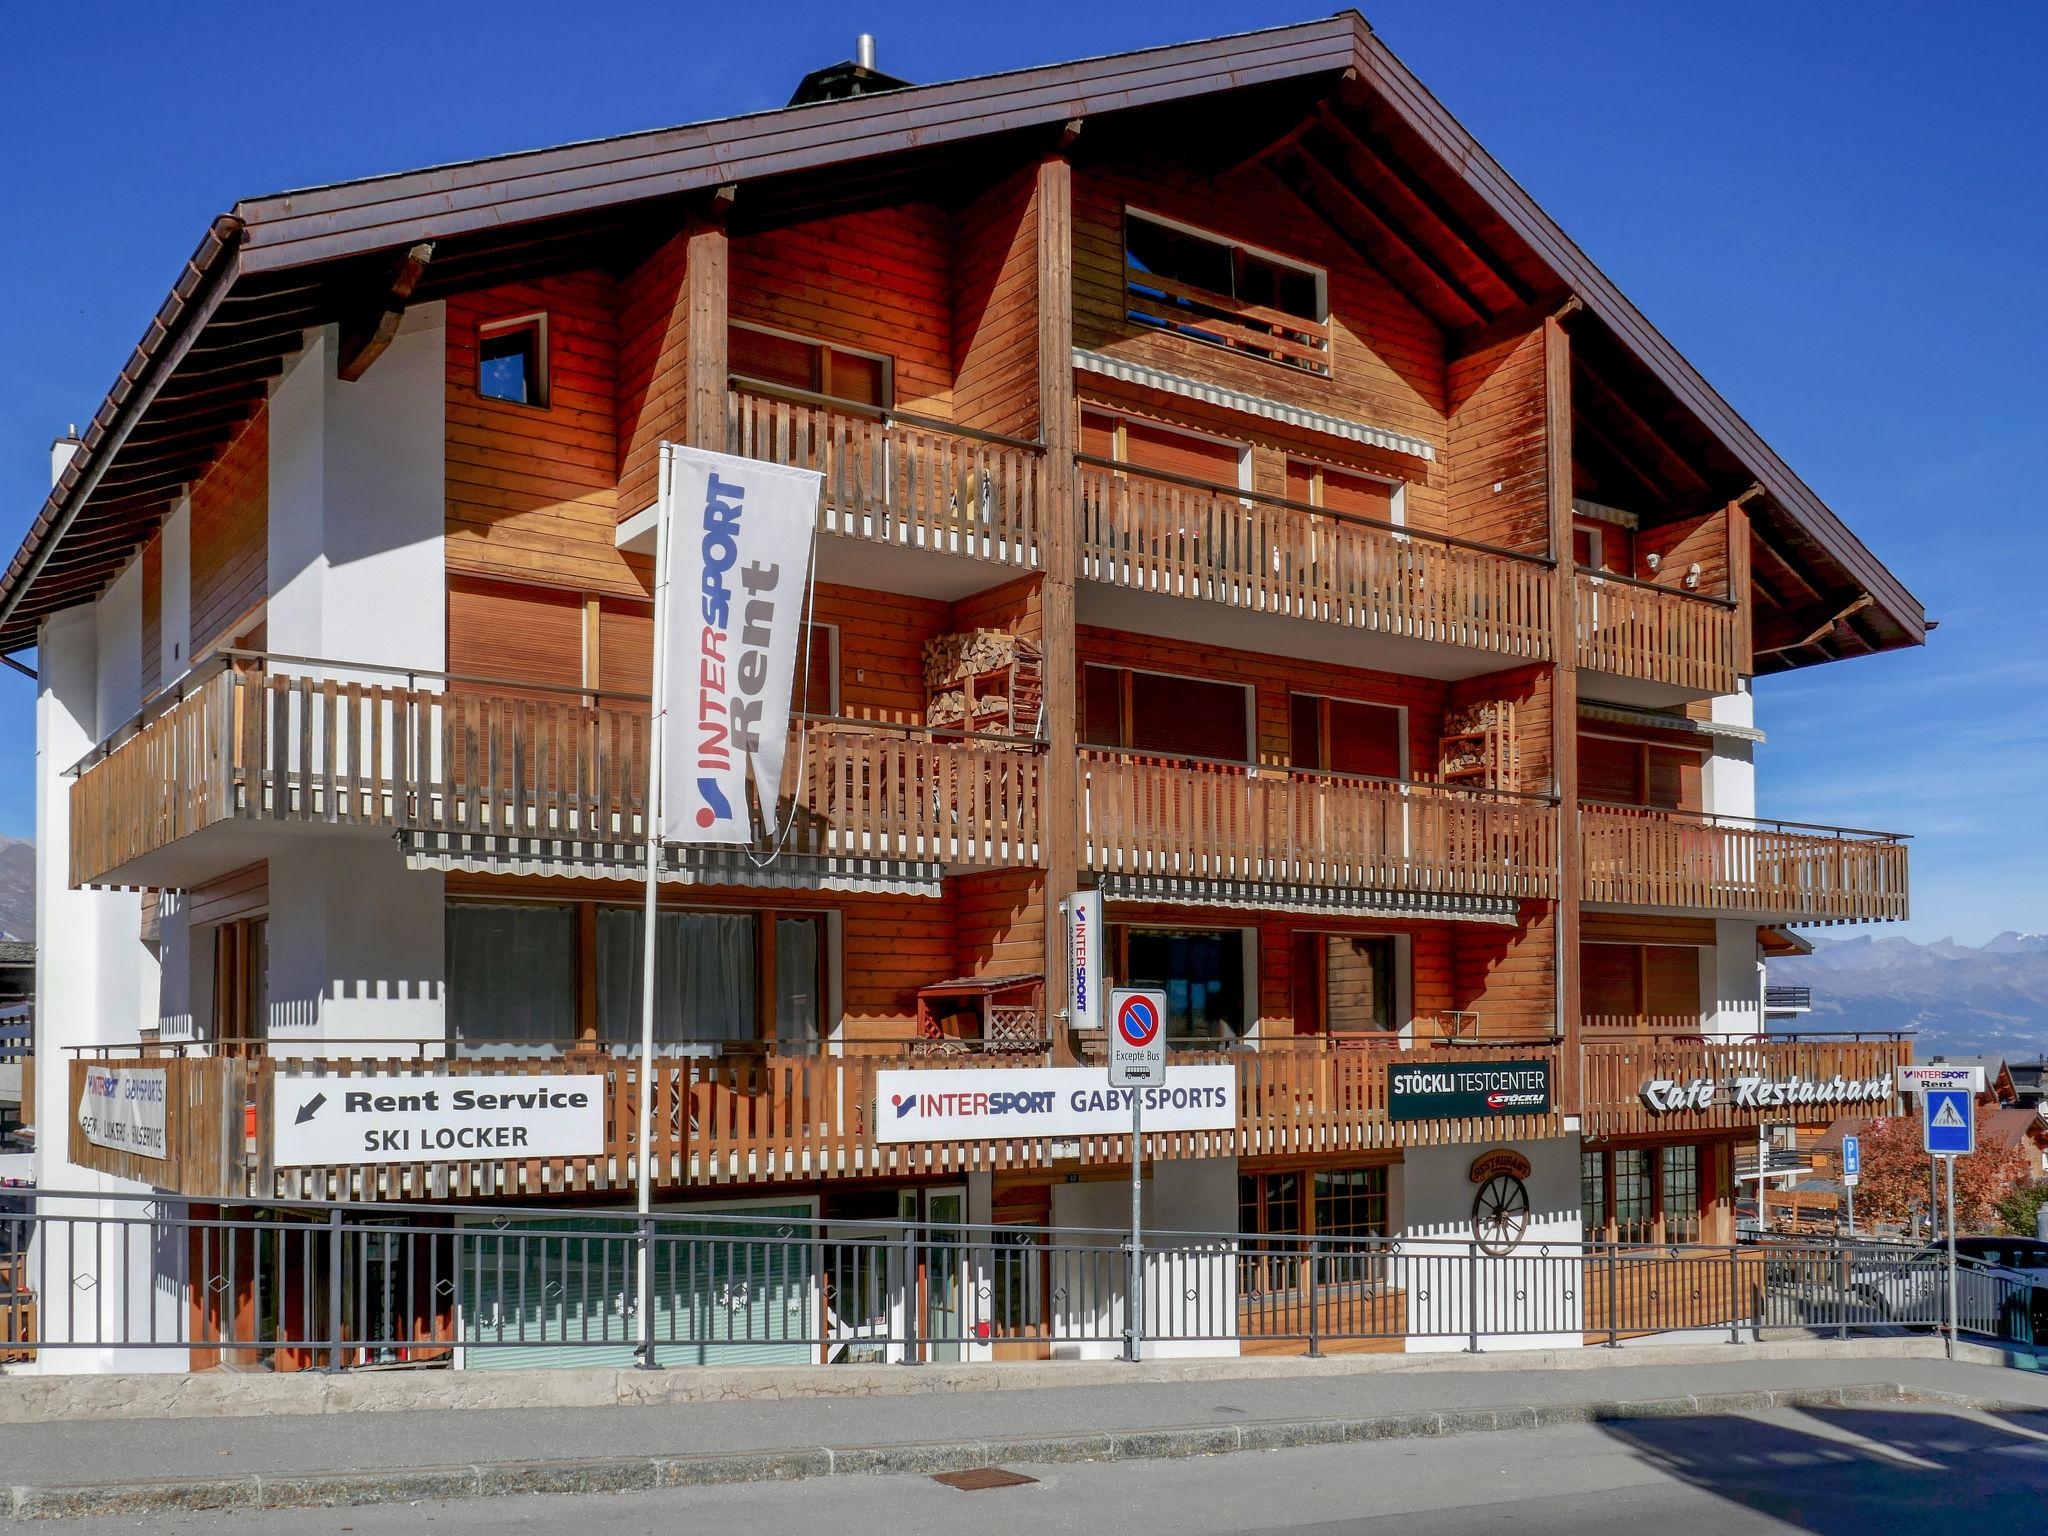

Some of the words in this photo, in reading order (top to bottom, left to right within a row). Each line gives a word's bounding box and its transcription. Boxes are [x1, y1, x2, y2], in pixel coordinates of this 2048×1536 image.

[696, 473, 746, 771] INTERSPORT
[730, 559, 780, 754] Rent
[1075, 923, 1087, 1011] INTERSPORT
[1116, 1050, 1145, 1062] Excepté
[1147, 1051, 1160, 1060] Bus
[91, 1074, 119, 1098] INTERSRT
[1394, 1070, 1455, 1094] STÖCKLI
[1457, 1071, 1545, 1092] TESTCENTER
[1914, 1070, 1969, 1079] INTERSPORT
[1921, 1080, 1953, 1088] Rent
[345, 1090, 439, 1113] Rent
[452, 1087, 588, 1110] Service
[920, 1091, 1056, 1118] INTERSPORT
[1488, 1094, 1545, 1103] STÖCKLI
[1646, 1079, 1715, 1111] Café
[1733, 1073, 1893, 1107] Restaurant
[364, 1129, 410, 1151] SKI
[421, 1126, 529, 1150] LOCKER
